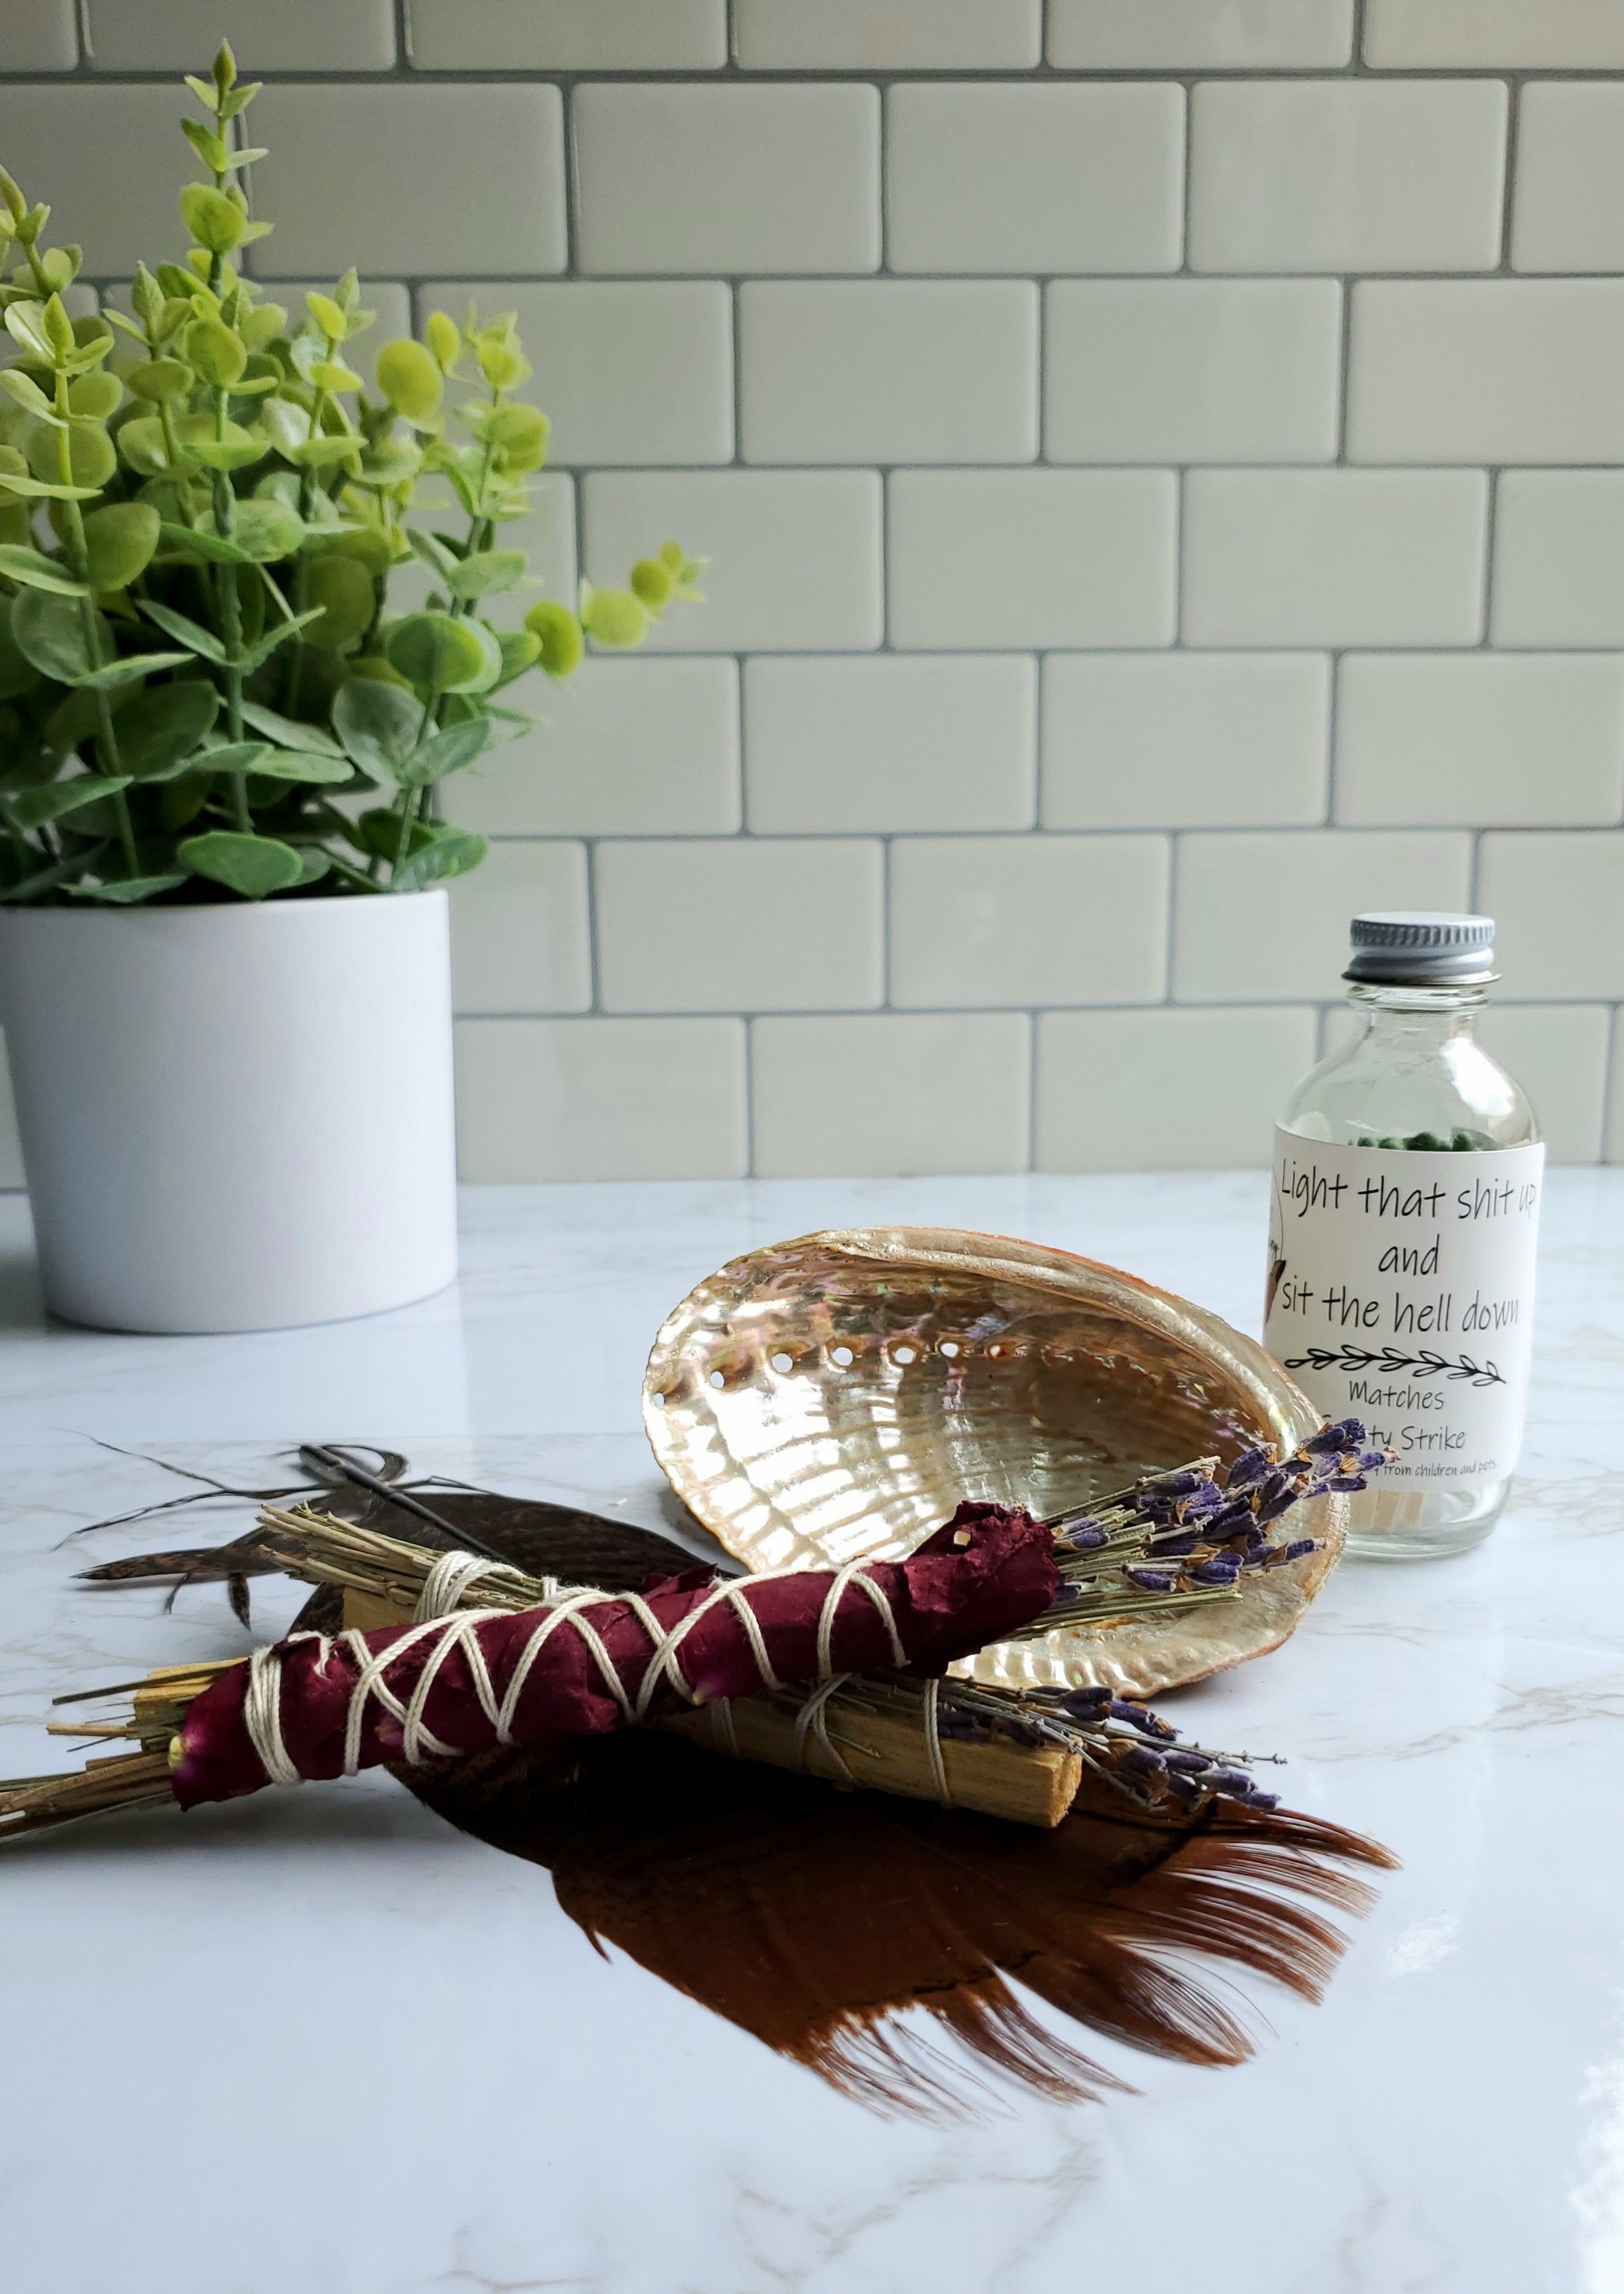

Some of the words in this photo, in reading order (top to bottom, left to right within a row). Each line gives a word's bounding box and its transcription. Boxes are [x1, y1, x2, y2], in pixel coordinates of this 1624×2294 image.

[1281, 1158, 1348, 1217] Light
[1358, 1175, 1446, 1218] that
[1458, 1178, 1514, 1220] shit
[1519, 1182, 1536, 1218] up
[1378, 1233, 1440, 1276] and
[1282, 1274, 1314, 1314] sit
[1322, 1285, 1379, 1327] the
[1393, 1292, 1451, 1333] hell
[1462, 1290, 1519, 1331] down
[1349, 1380, 1444, 1410] Matches
[1401, 1425, 1466, 1450] Strike
[1383, 1462, 1411, 1476] from
[1415, 1462, 1457, 1476] children
[1460, 1459, 1476, 1475] and
